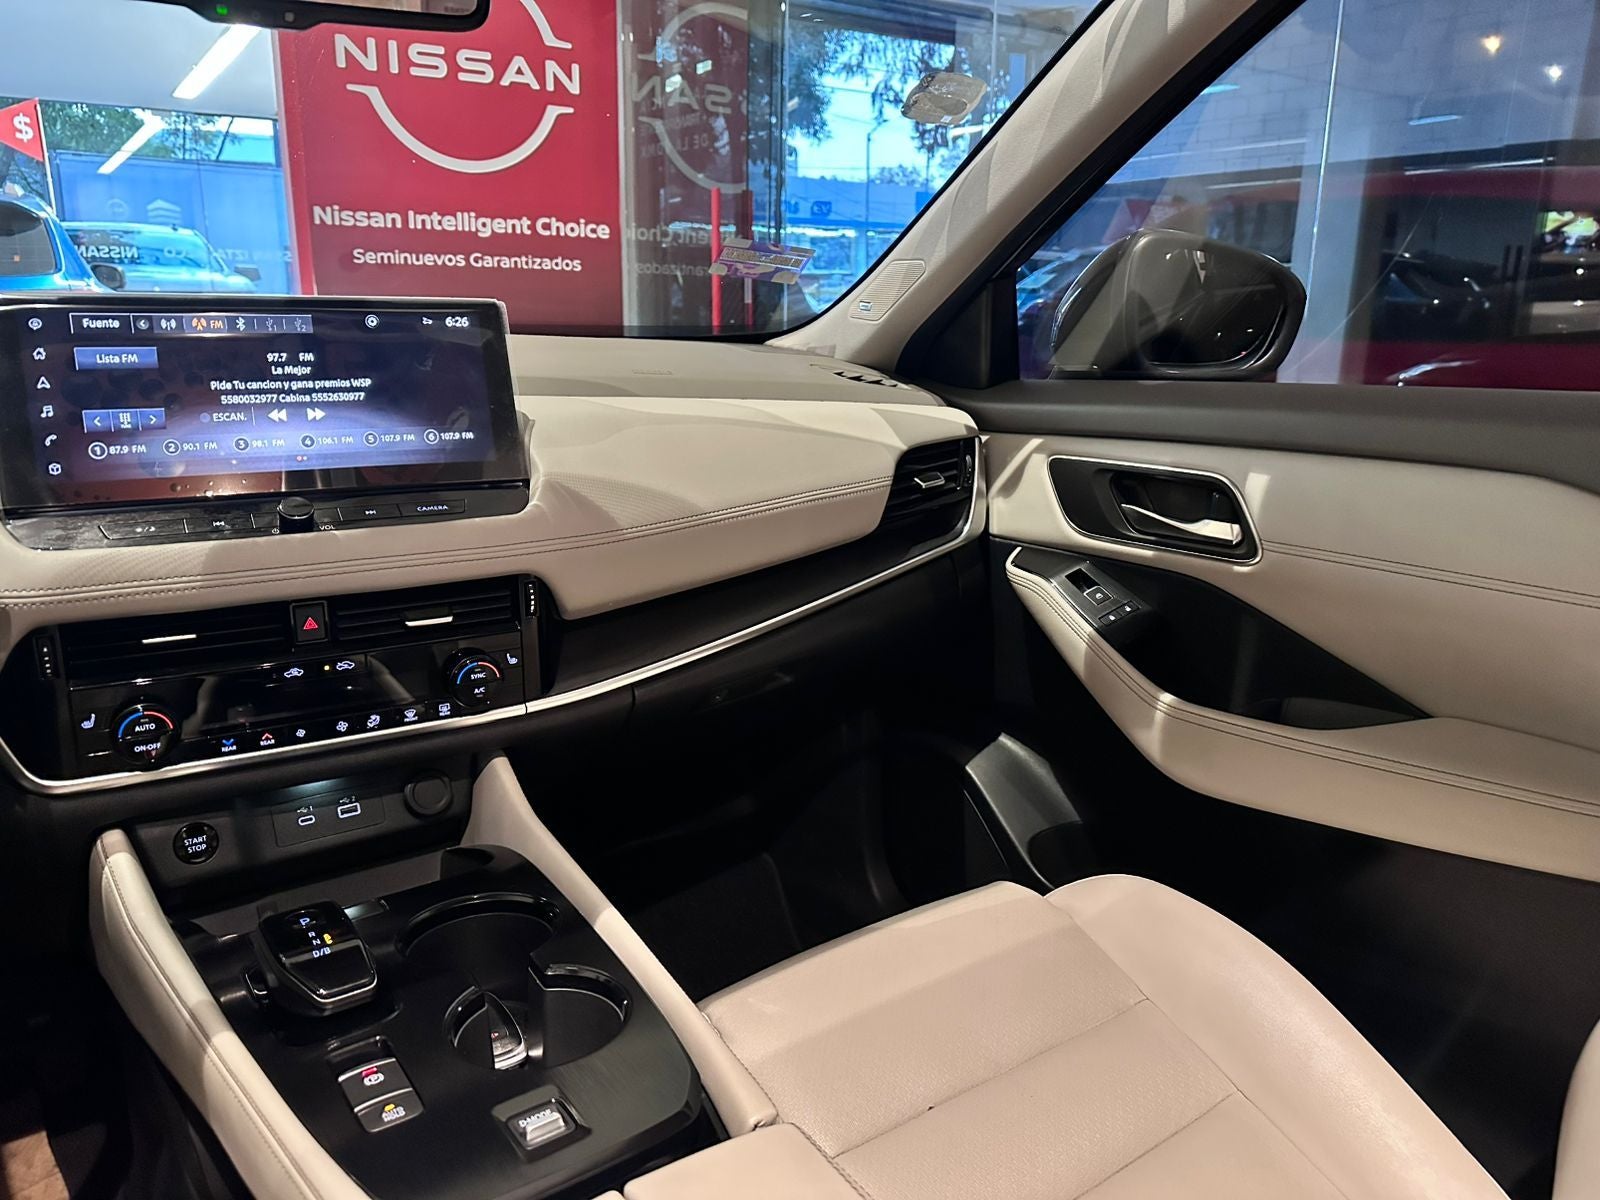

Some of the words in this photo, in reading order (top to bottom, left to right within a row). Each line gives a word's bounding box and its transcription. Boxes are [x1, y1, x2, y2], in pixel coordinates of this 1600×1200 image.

[334, 33, 581, 95] NISSAN
[312, 205, 402, 229] Nissan
[408, 210, 532, 238] Intelligent
[535, 217, 610, 239] Choice
[353, 248, 466, 267] Seminuevos
[469, 252, 582, 272] Garantizados
[82, 317, 121, 329] Fuente
[210, 319, 224, 329] FM
[445, 316, 469, 328] 6:26
[96, 353, 119, 364] Lista
[122, 353, 139, 364] FM
[266, 352, 287, 362] 97.7
[299, 352, 315, 362] FM
[271, 365, 283, 375] La
[284, 365, 312, 377] Mejor
[210, 380, 232, 391] Pide
[232, 380, 245, 391] Tu
[246, 380, 283, 390] cancion
[283, 381, 290, 391] y
[290, 380, 314, 391] gana
[315, 378, 350, 390] premios
[279, 391, 310, 403] Cabina
[212, 411, 248, 423] ESCAN.
[341, 436, 354, 445] FM
[403, 434, 415, 442] FM
[462, 431, 475, 440] FM
[204, 441, 218, 451] FM
[271, 439, 285, 447] FM
[131, 444, 147, 454] FM
[416, 504, 449, 512] CAMERA
[470, 671, 487, 680] SYNC
[474, 686, 486, 694] A/C
[135, 722, 156, 732] AUTO
[184, 834, 207, 846] START
[187, 843, 207, 854] STOP
[300, 917, 311, 926] P
[312, 946, 331, 958] D/B
